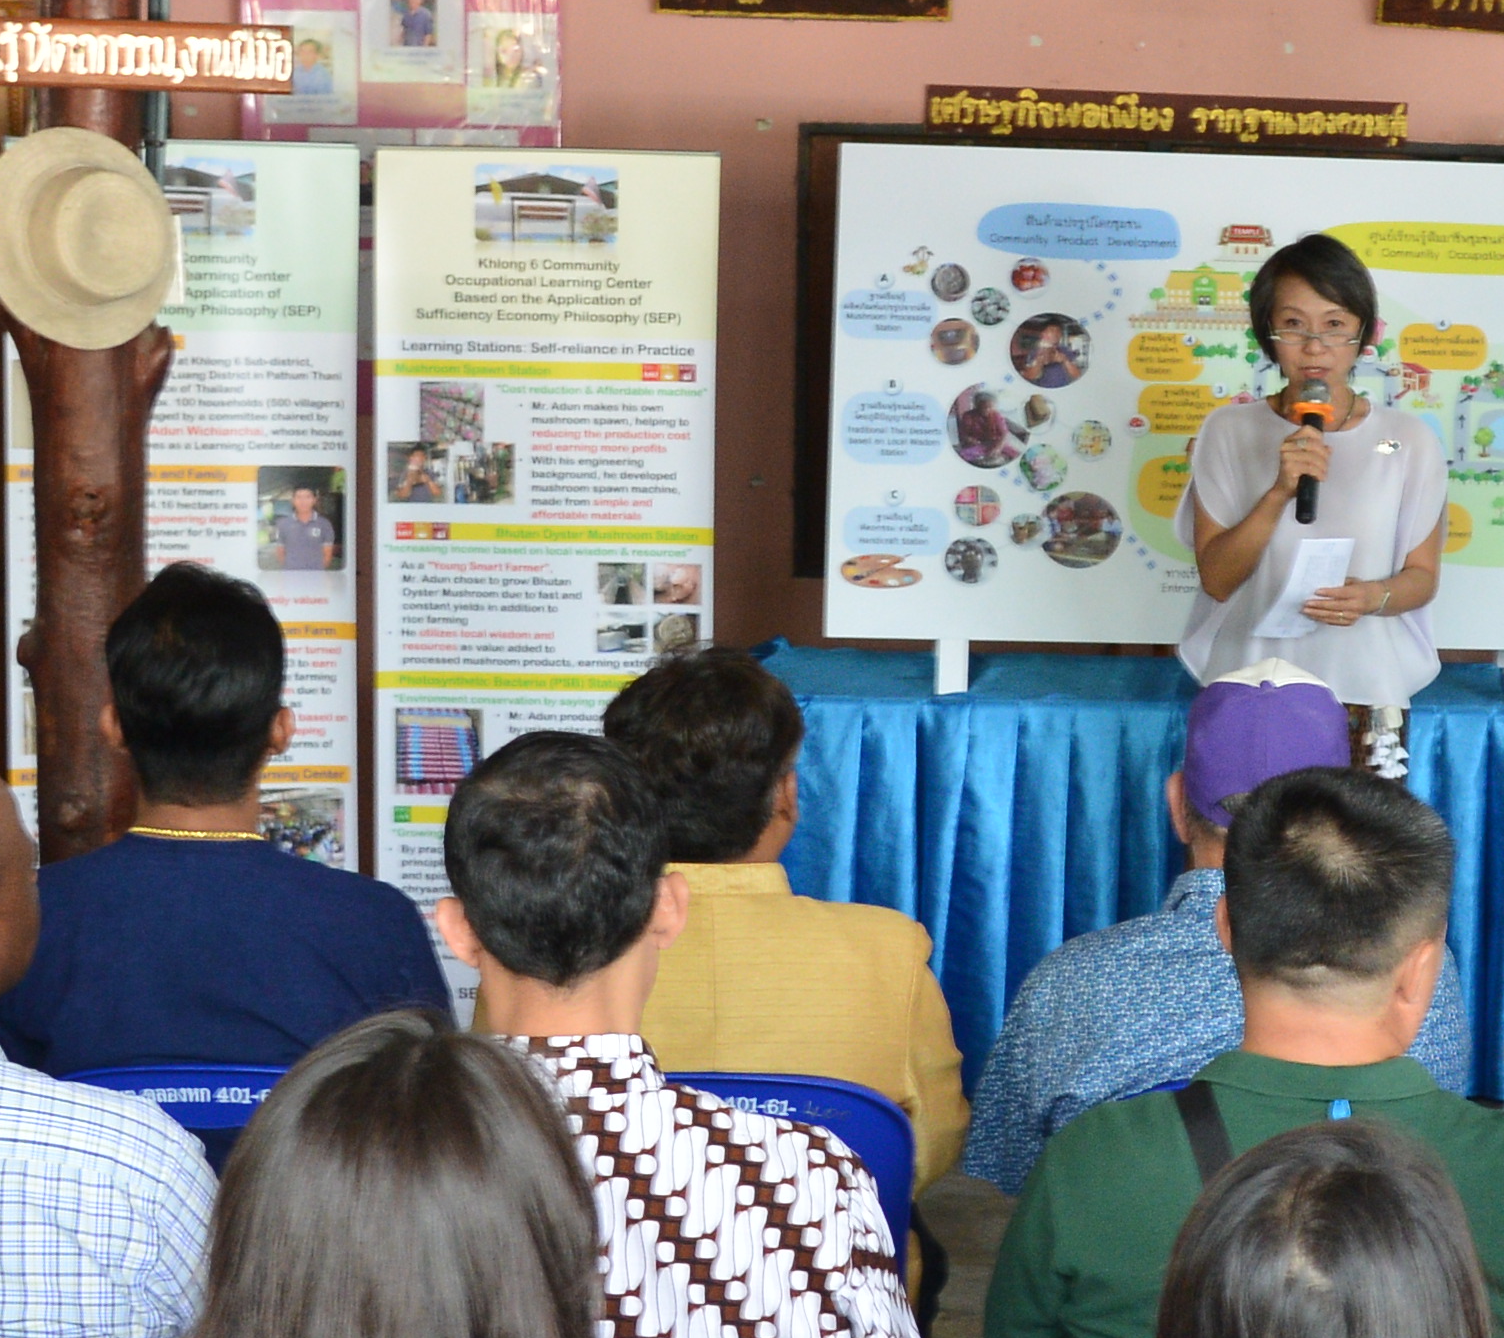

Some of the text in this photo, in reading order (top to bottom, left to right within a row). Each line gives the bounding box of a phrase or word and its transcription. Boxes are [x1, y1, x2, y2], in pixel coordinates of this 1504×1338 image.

[930, 88, 1175, 136] เศรษฐกิจพอเพียง
[990, 232, 1178, 251] Community Product Development
[1365, 248, 1373, 257] 6
[1379, 248, 1441, 261] Community
[477, 258, 620, 274] Khlong 6 Community
[445, 275, 652, 291] Occupational Learning Center
[268, 288, 281, 299] of
[453, 292, 643, 308] Based on the Application of
[200, 304, 322, 320] Philosophy (SEP)
[416, 308, 682, 327] Sufficiency Economy Philosophy (SEP)
[401, 340, 695, 356] Learning Stations: Self-reliance in Practice
[395, 363, 552, 377] Mushroom Spawn Station
[496, 527, 698, 542] Bhutan Oyster Mushroom Station
